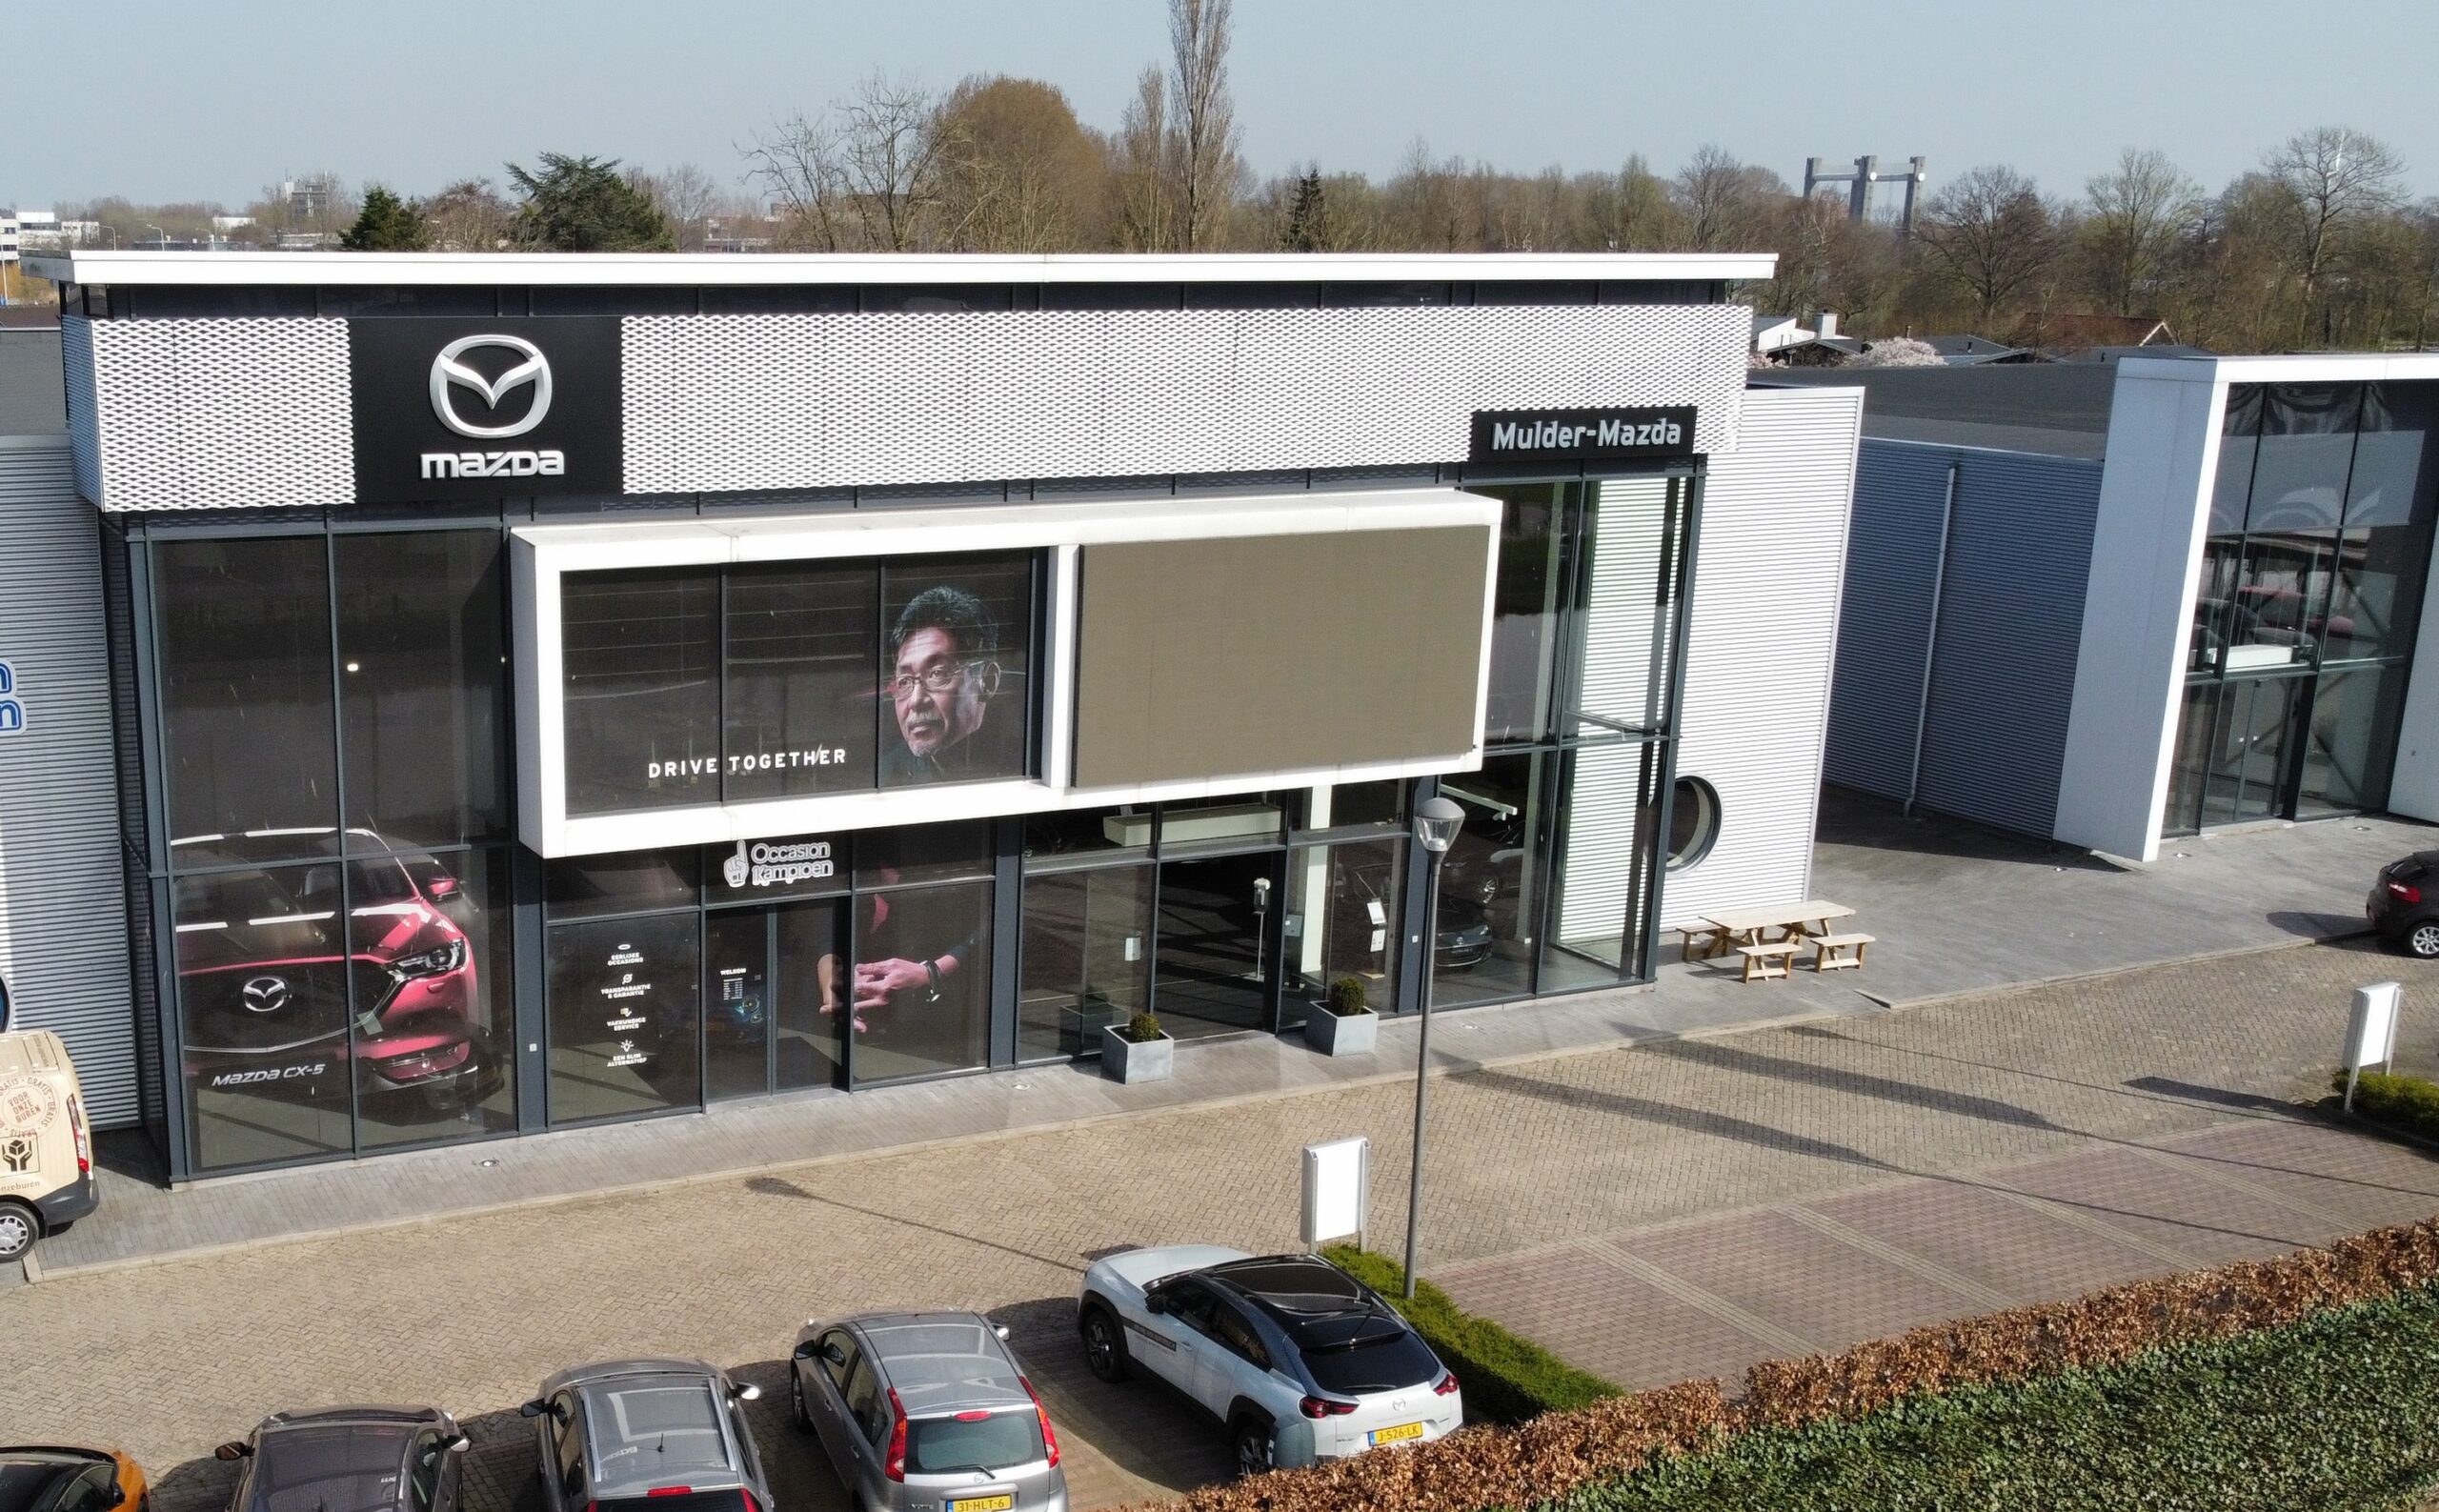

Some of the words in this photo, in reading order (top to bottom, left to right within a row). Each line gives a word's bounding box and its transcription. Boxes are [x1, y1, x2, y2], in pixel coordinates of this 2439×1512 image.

[1491, 417, 1682, 451] Mulder-Mazda
[648, 758, 717, 778] DRIVE
[729, 749, 846, 772] TOGETHER
[751, 842, 831, 864] Occasion
[752, 859, 834, 887] Kampioen
[607, 957, 644, 966] OCCASIONS
[606, 1057, 648, 1068] ALTERNATIEF
[283, 1063, 326, 1079] CX-5
[8, 1091, 29, 1107] VOOR
[12, 1099, 33, 1115] ONZE
[15, 1105, 42, 1123] BUREN
[1379, 1424, 1419, 1441] J-526-LK
[958, 1499, 1005, 1512] 31-HLT-6
